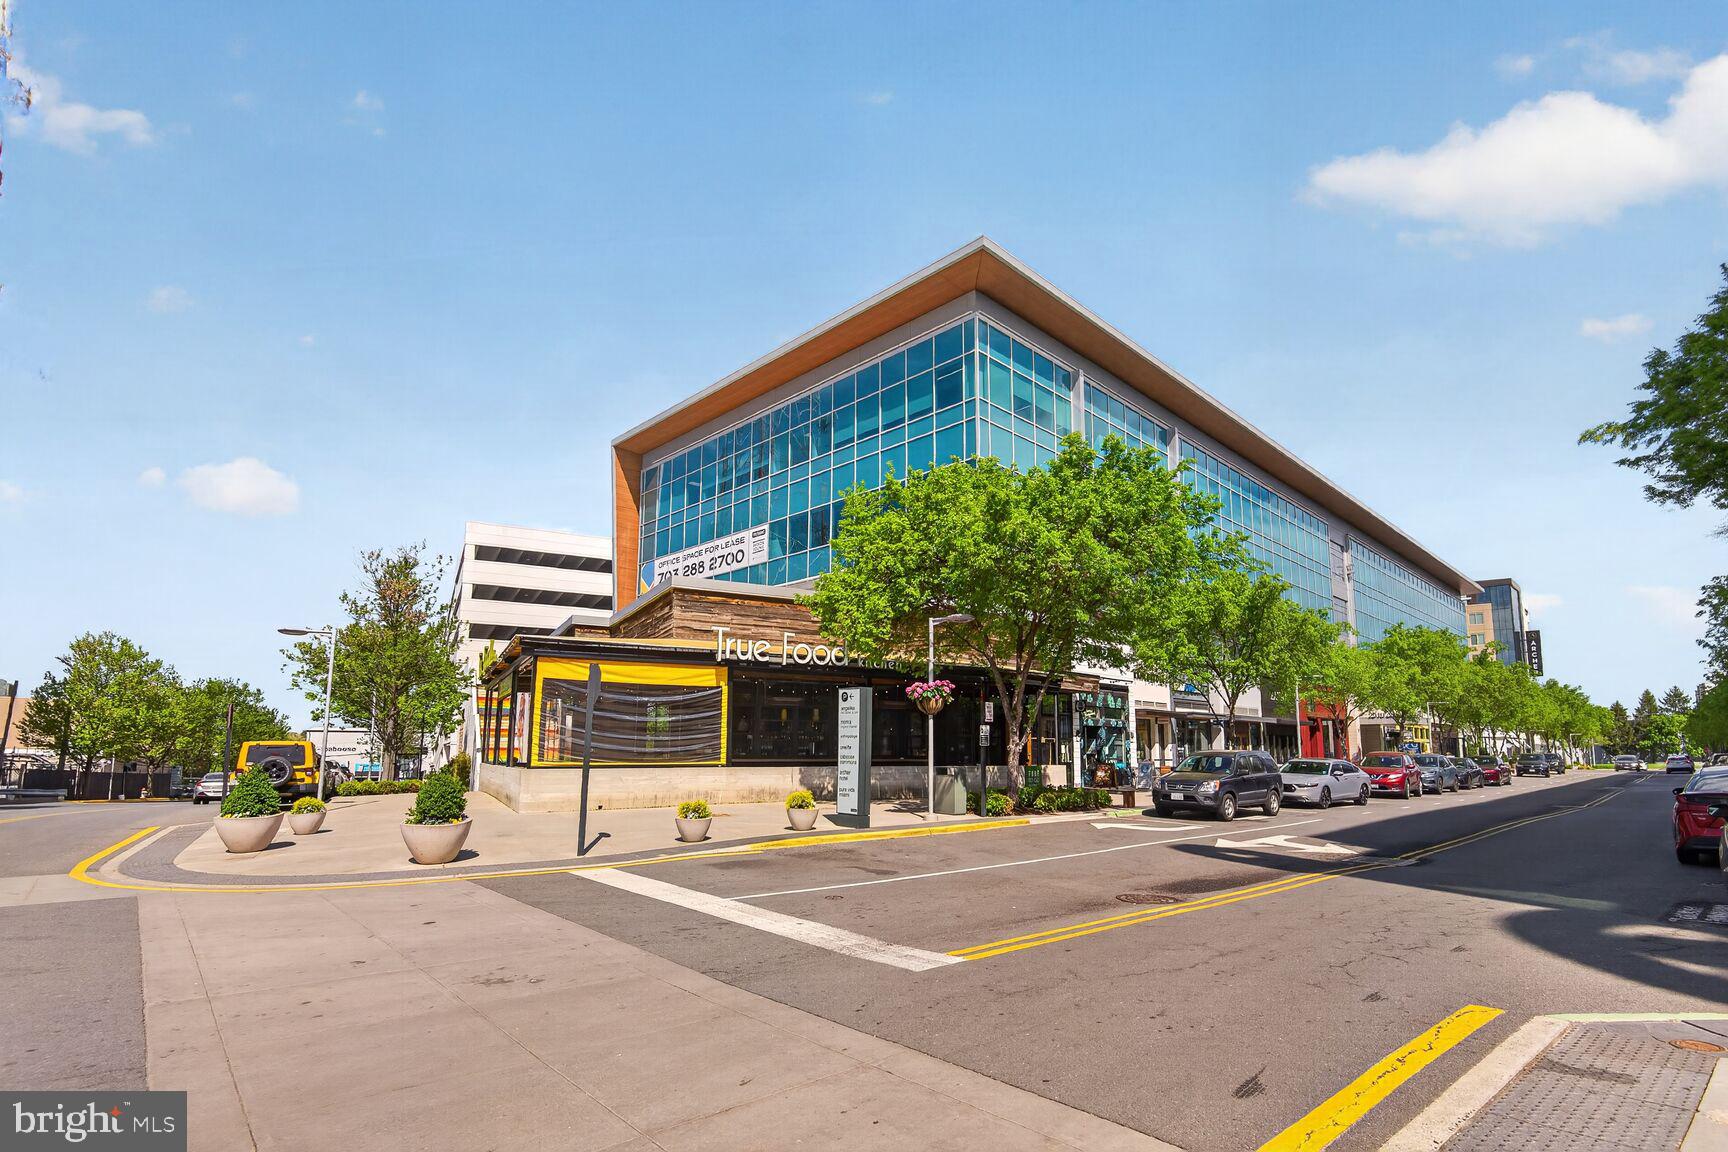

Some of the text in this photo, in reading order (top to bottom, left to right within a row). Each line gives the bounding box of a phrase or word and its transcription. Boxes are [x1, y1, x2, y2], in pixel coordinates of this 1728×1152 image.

[658, 556, 681, 569] OFFICE
[682, 549, 704, 562] SPACE
[704, 544, 720, 555] FOR
[721, 536, 746, 550] LEASE
[682, 560, 706, 577] 288
[708, 549, 745, 571] 2700
[711, 625, 772, 662] True
[781, 631, 849, 667] Food
